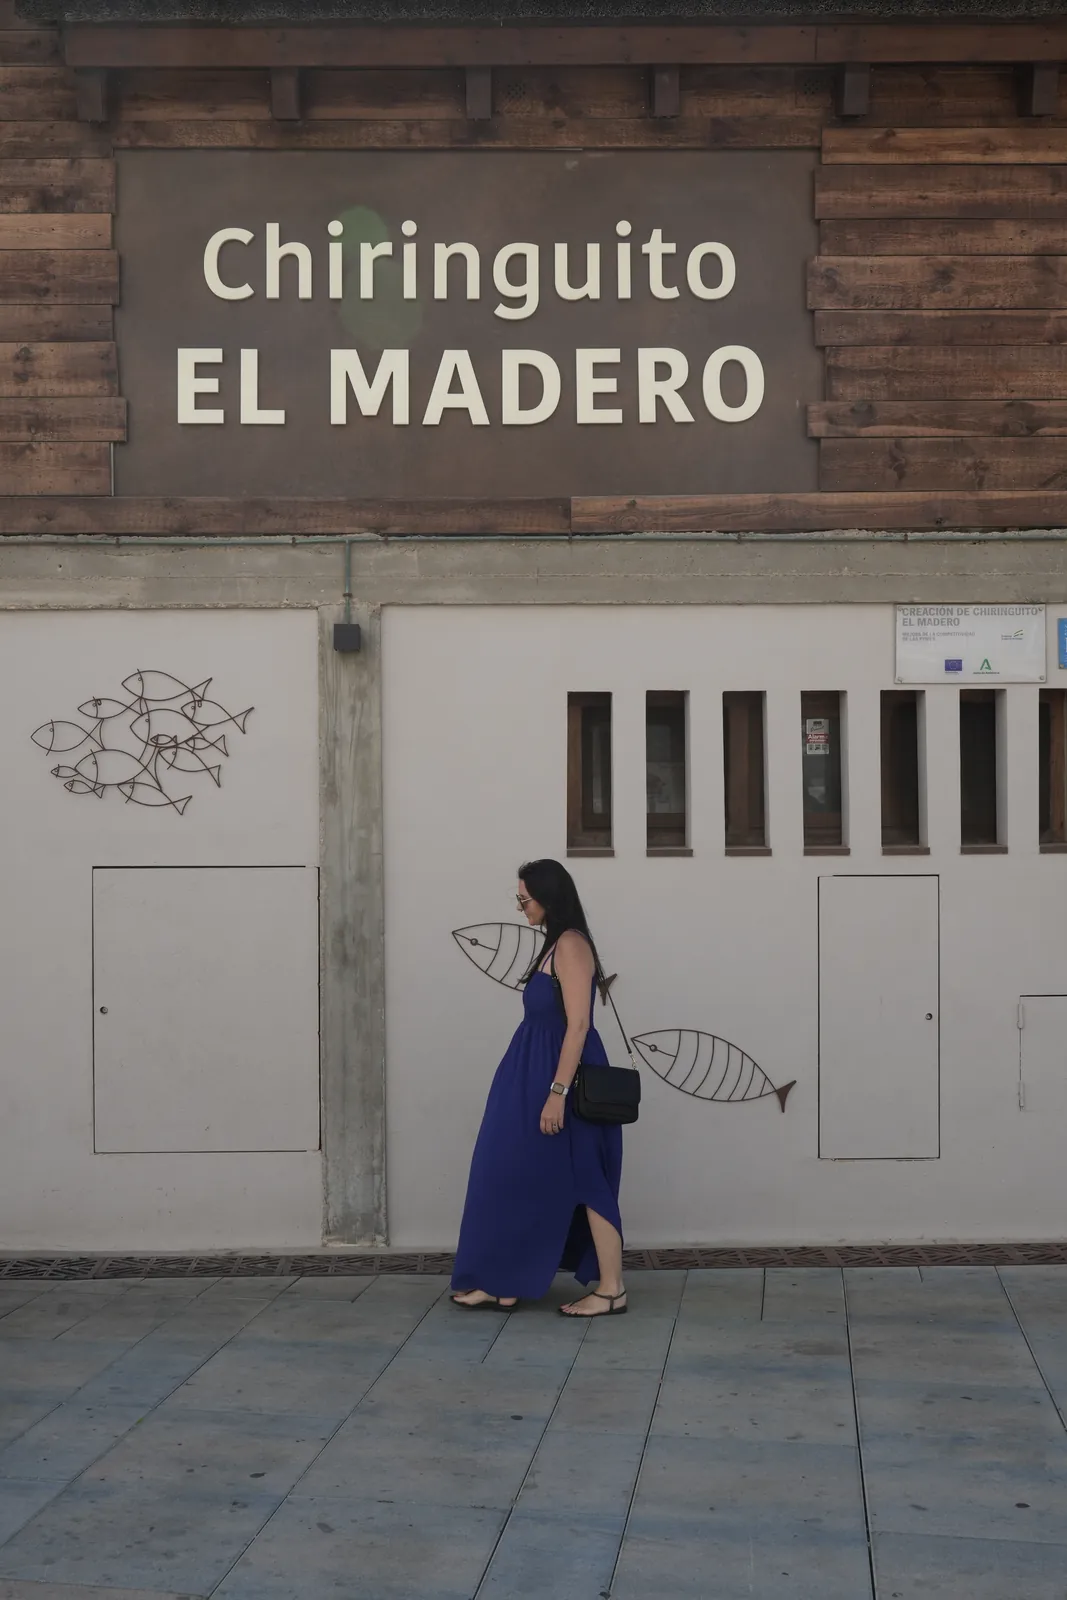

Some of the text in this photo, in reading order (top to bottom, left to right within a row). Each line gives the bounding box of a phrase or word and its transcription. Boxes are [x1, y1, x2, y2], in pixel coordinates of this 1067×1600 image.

[202, 219, 737, 320] Chiringuito
[177, 344, 766, 426] EL MADERO
[902, 605, 1038, 616] CREACIÓN DE CHIRINGUITO
[902, 618, 960, 627] EL MADERO
